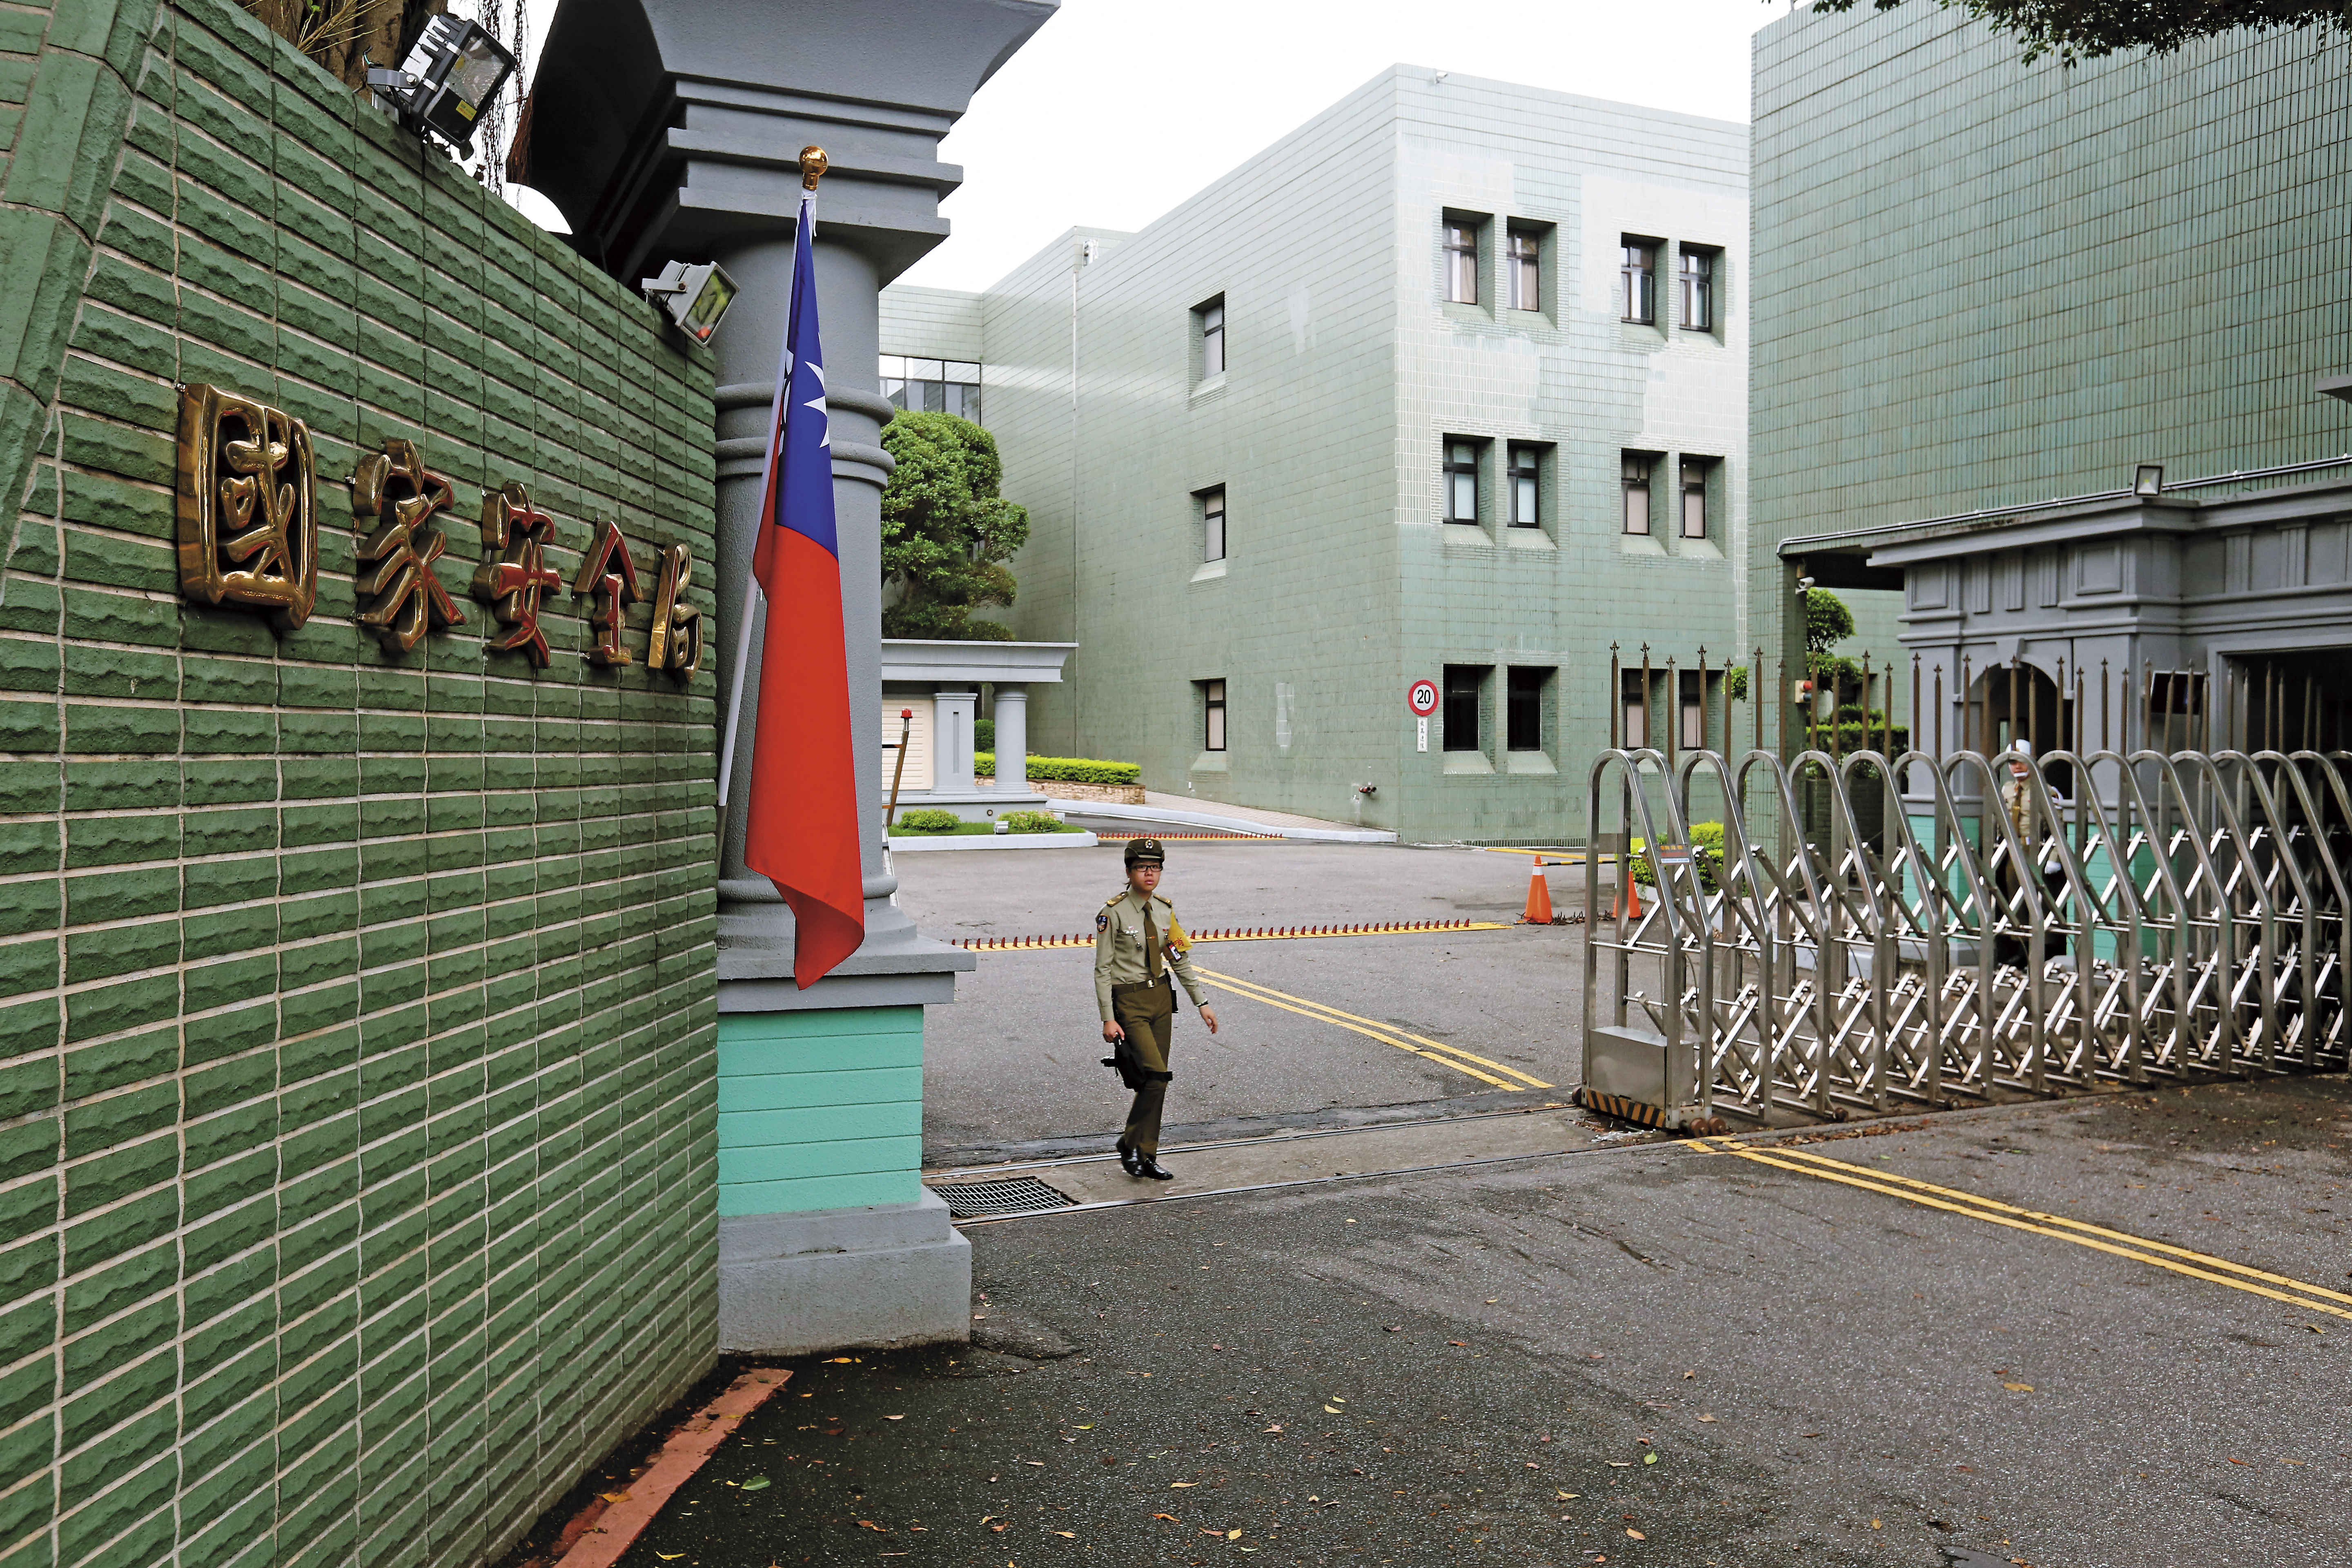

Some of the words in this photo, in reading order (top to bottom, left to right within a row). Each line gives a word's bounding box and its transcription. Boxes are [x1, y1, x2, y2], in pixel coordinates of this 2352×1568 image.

[177, 383, 703, 684] 國家安全局
[1417, 689, 1431, 704] 20
